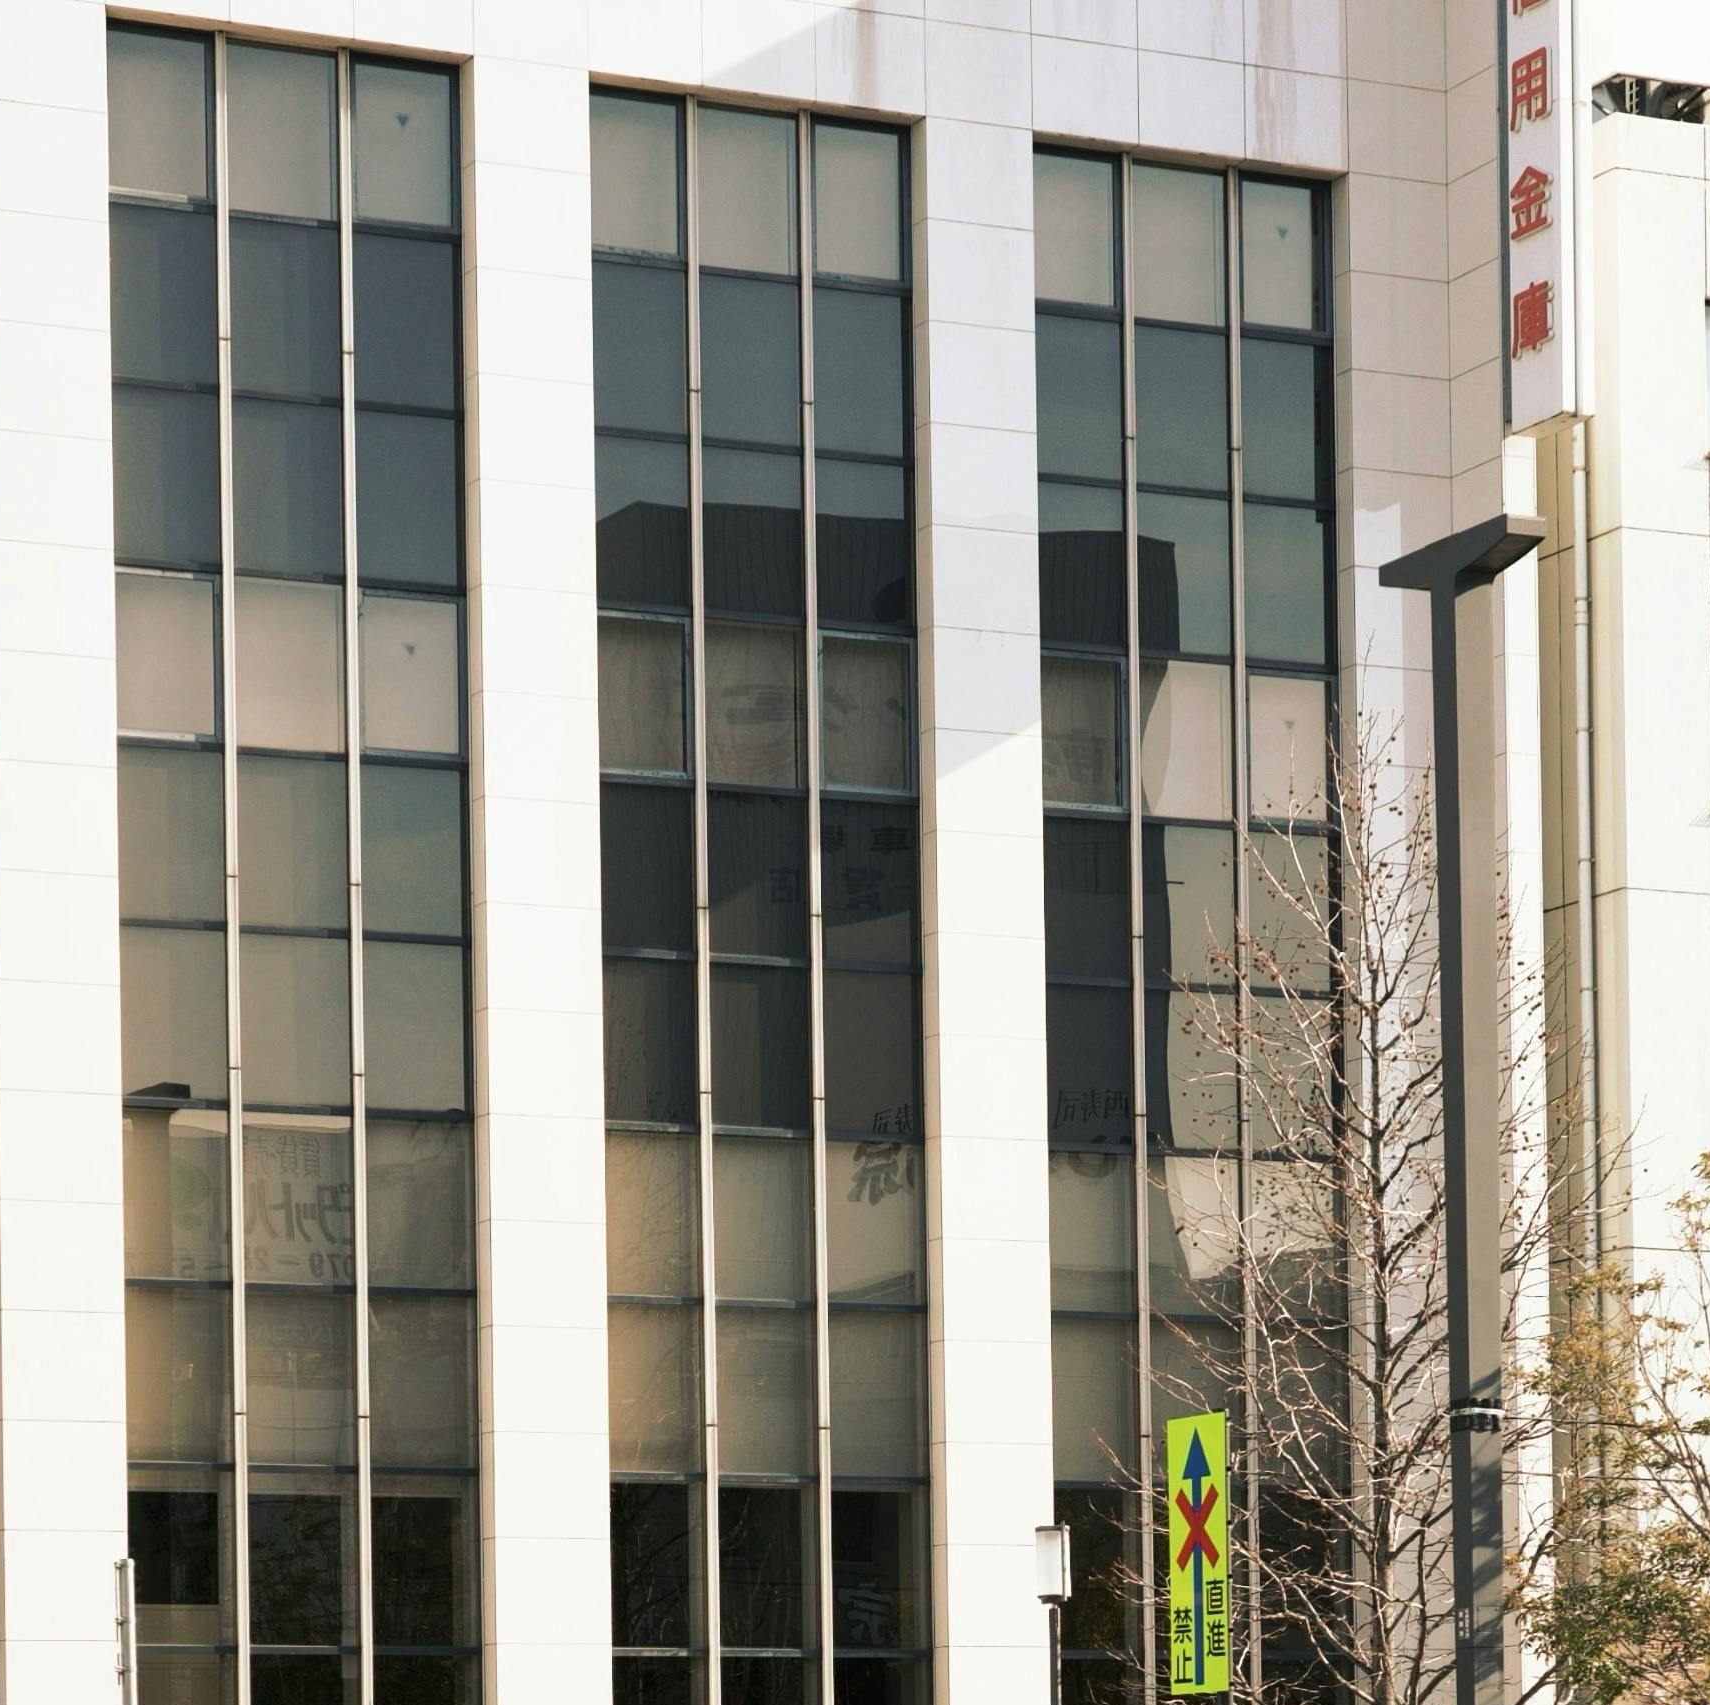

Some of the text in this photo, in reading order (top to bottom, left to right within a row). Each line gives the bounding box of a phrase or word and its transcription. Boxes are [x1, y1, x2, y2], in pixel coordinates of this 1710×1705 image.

[1509, 0, 1554, 361] 用金庫
[1173, 1606, 1193, 1684] 禁止
[1206, 1579, 1226, 1657] 直進
